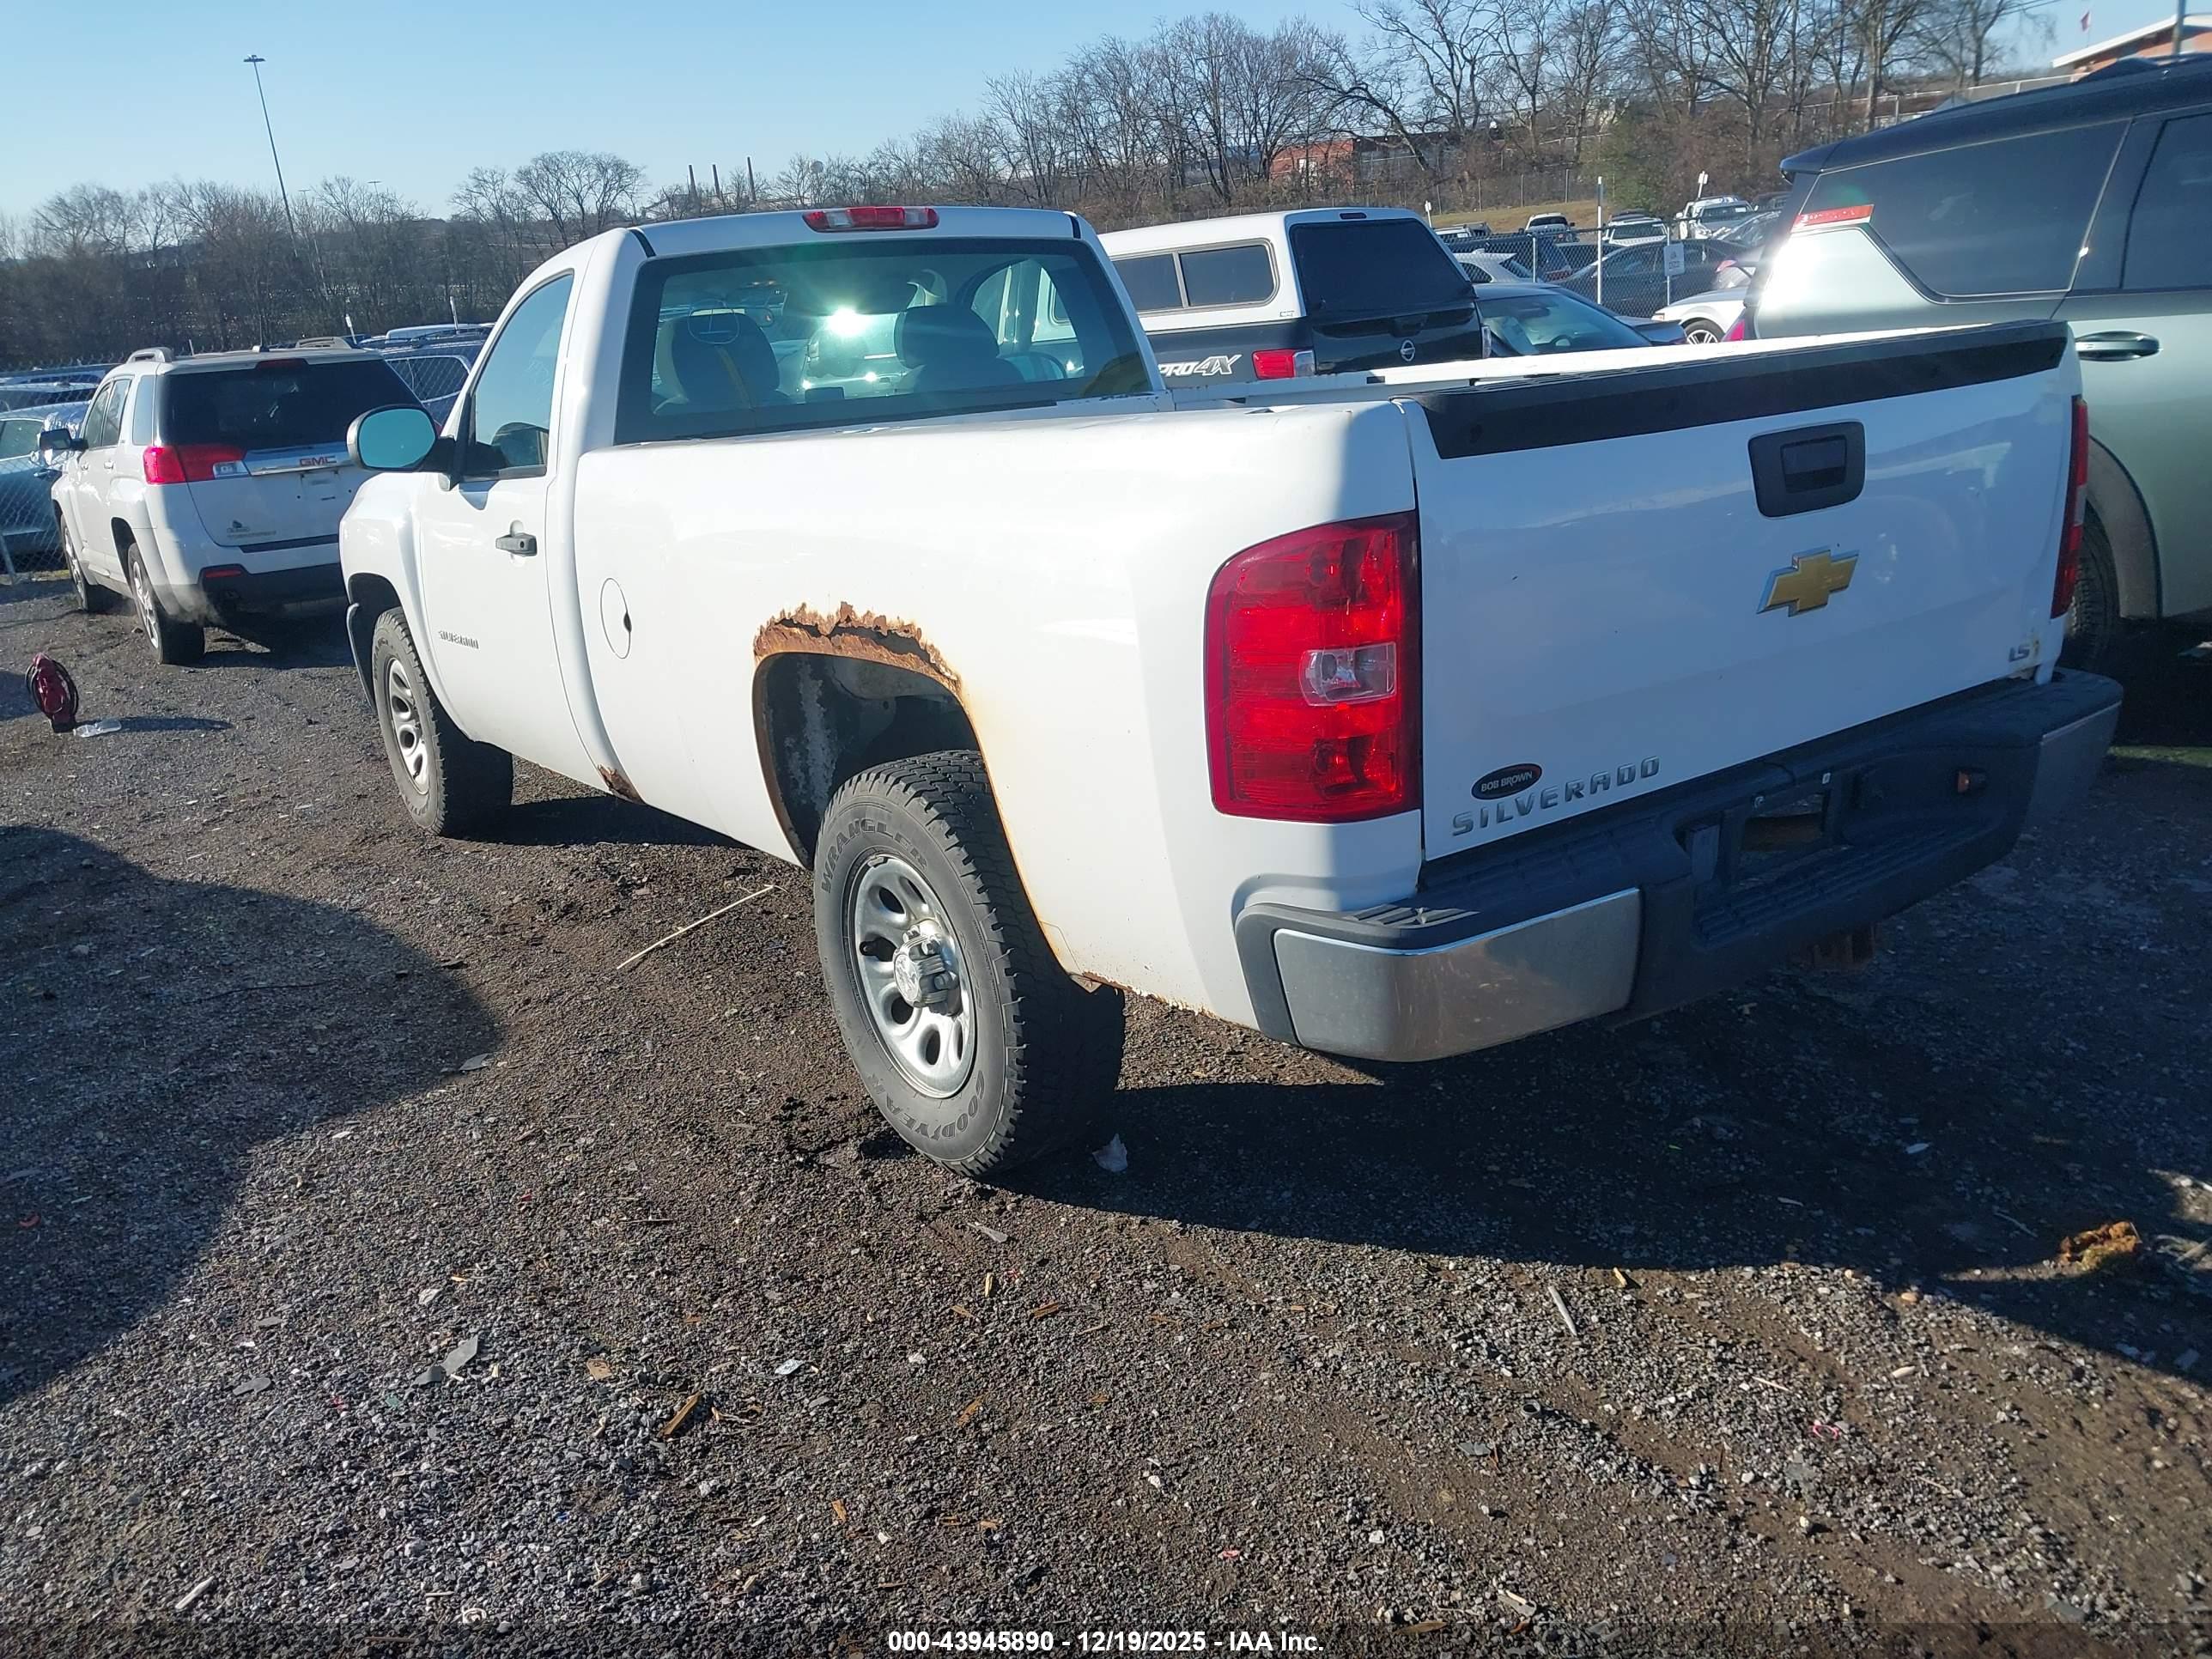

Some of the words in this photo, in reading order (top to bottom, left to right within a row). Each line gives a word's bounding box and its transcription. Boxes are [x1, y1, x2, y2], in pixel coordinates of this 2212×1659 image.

[299, 455, 337, 467] GMC
[1452, 756, 1661, 836] SILVERADO
[1480, 779, 1500, 793] BOB
[1500, 770, 1534, 788] BROWN
[821, 817, 928, 894] WRANGLER
[873, 1069, 985, 1141] GOODYEAR
